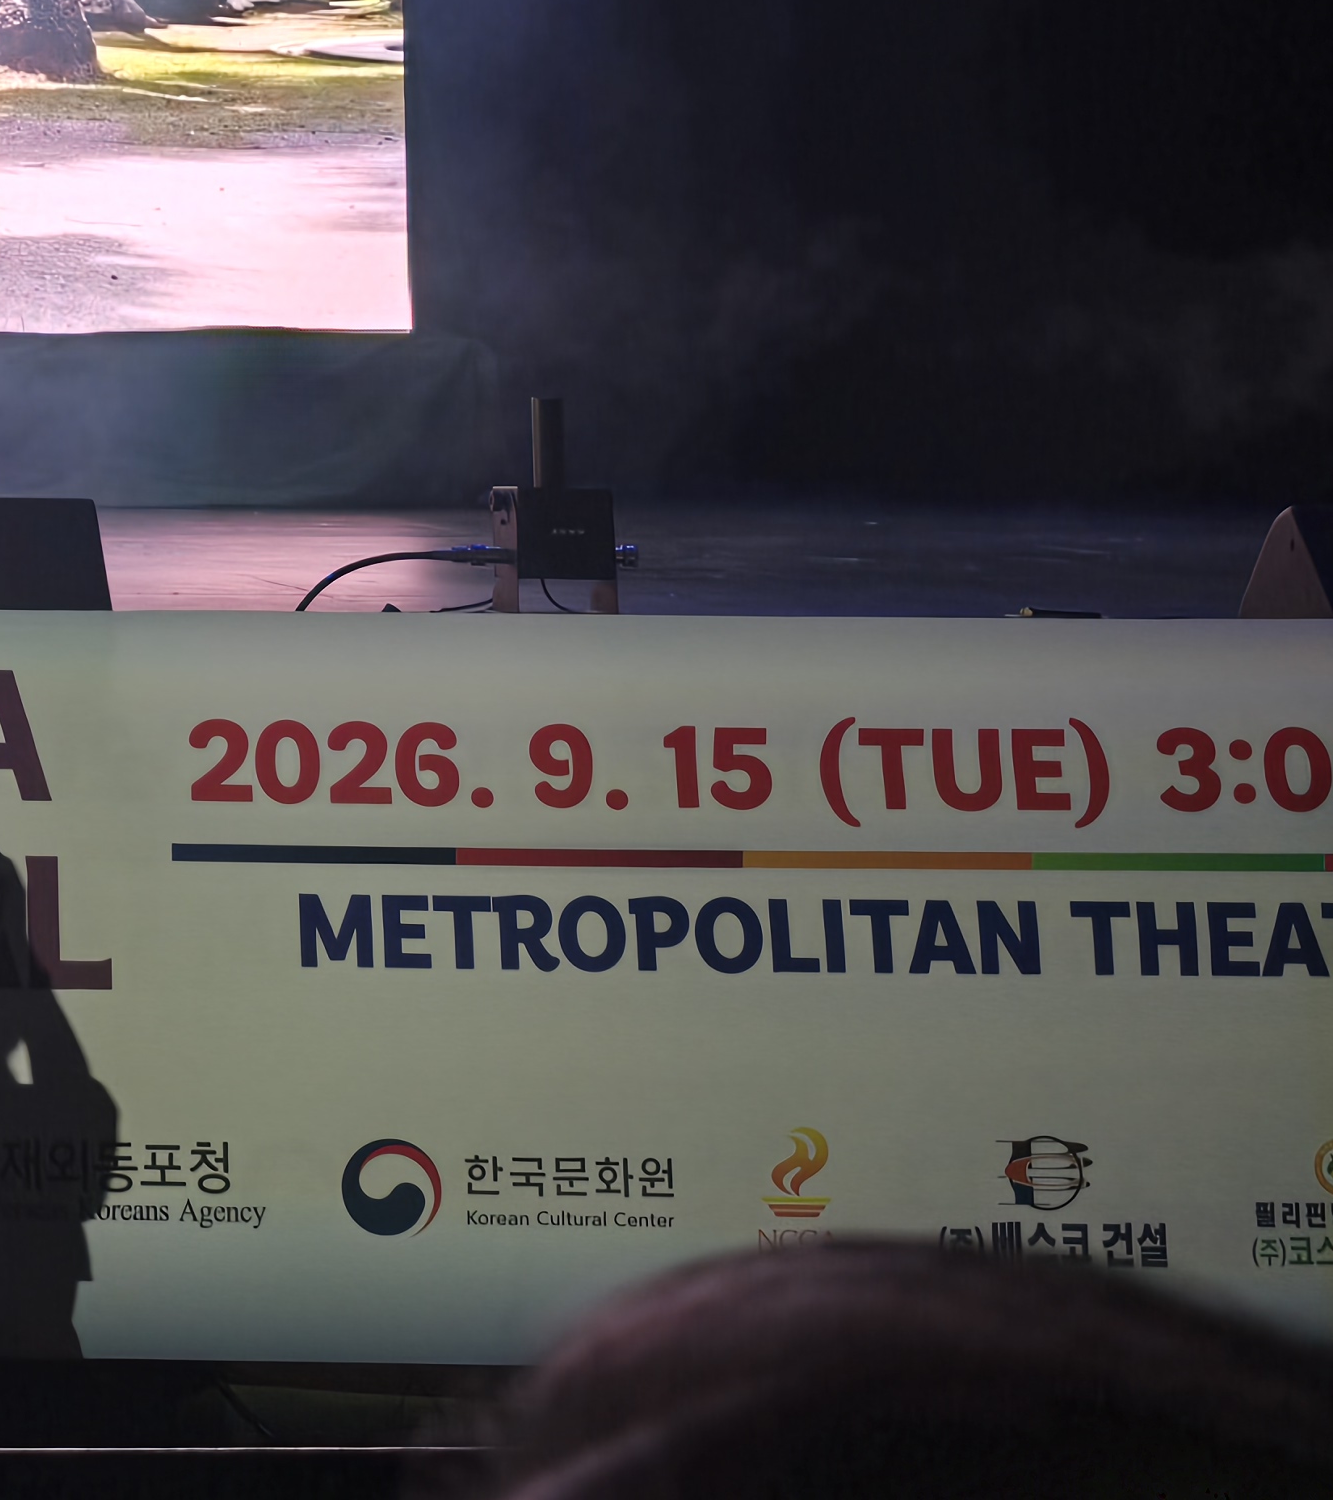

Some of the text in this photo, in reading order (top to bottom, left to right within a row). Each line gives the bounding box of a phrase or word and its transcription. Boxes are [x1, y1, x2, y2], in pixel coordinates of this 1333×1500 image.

[187, 718, 495, 809] 2026.
[528, 723, 629, 810] 9.
[663, 725, 773, 811] 15
[819, 717, 1111, 828] (TUE)
[298, 893, 1333, 977] METROPOLITAN THEA
[464, 1154, 675, 1198] 한국문화원
[179, 1198, 267, 1229] Agency
[466, 1209, 675, 1228] Korean Cultural Center
